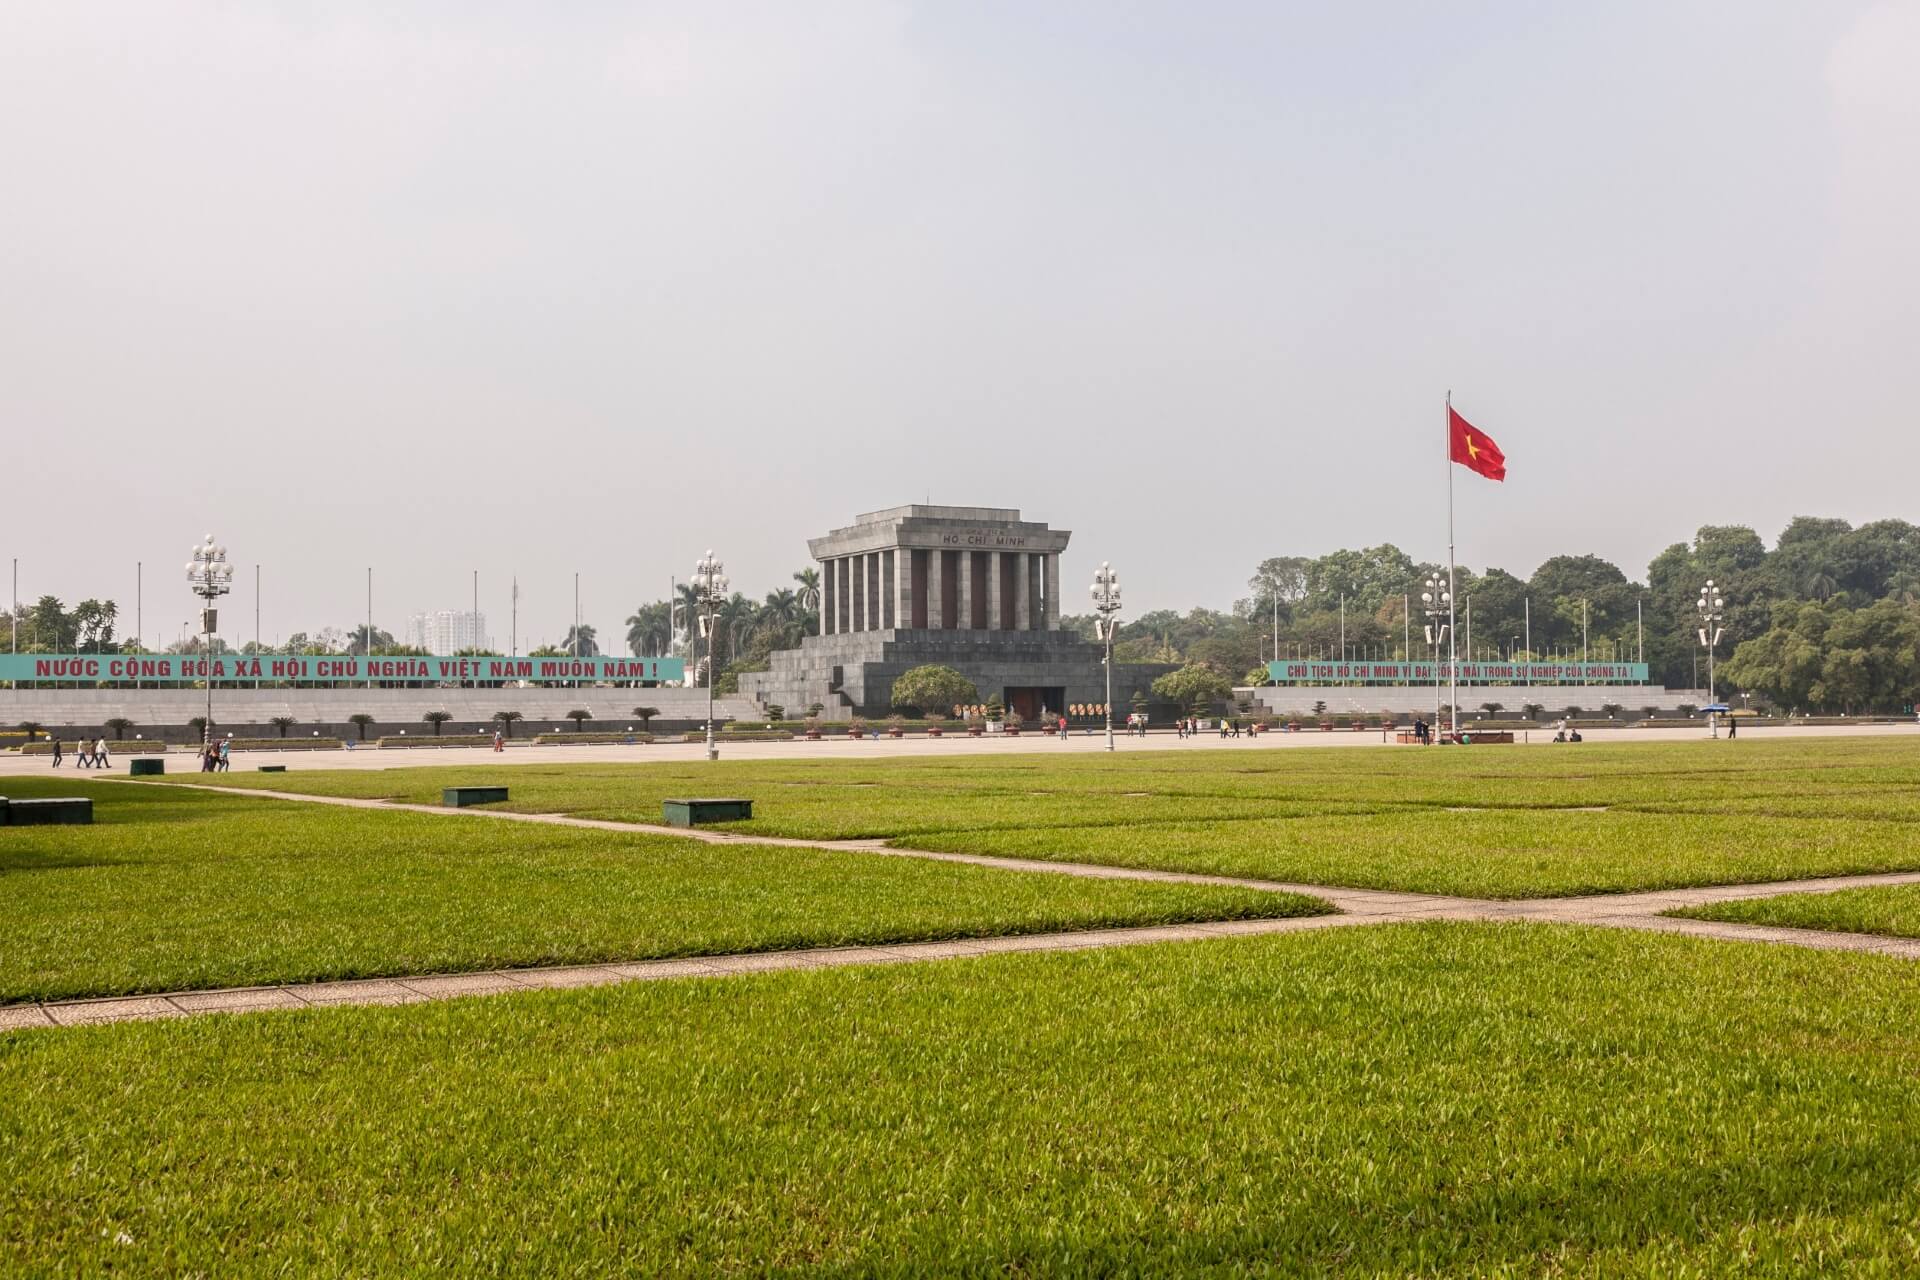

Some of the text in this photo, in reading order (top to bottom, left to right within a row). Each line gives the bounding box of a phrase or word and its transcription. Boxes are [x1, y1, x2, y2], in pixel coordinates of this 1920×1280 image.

[996, 536, 1025, 547] MINH
[36, 658, 99, 677] NƯỚC
[110, 657, 171, 680] CỘNG
[235, 658, 263, 677] XÃ
[272, 657, 307, 680] HỘI
[317, 657, 358, 677] CHỦ
[367, 658, 430, 677] NGHĨA
[440, 658, 480, 679] VIỆT
[490, 661, 533, 677] NAM
[541, 659, 596, 677] MUÔN
[603, 659, 644, 677] NĂM
[1311, 665, 1334, 680] TỊCH
[1373, 665, 1399, 678] MINH
[1483, 665, 1513, 678] TRONG
[1617, 666, 1627, 678] TA
